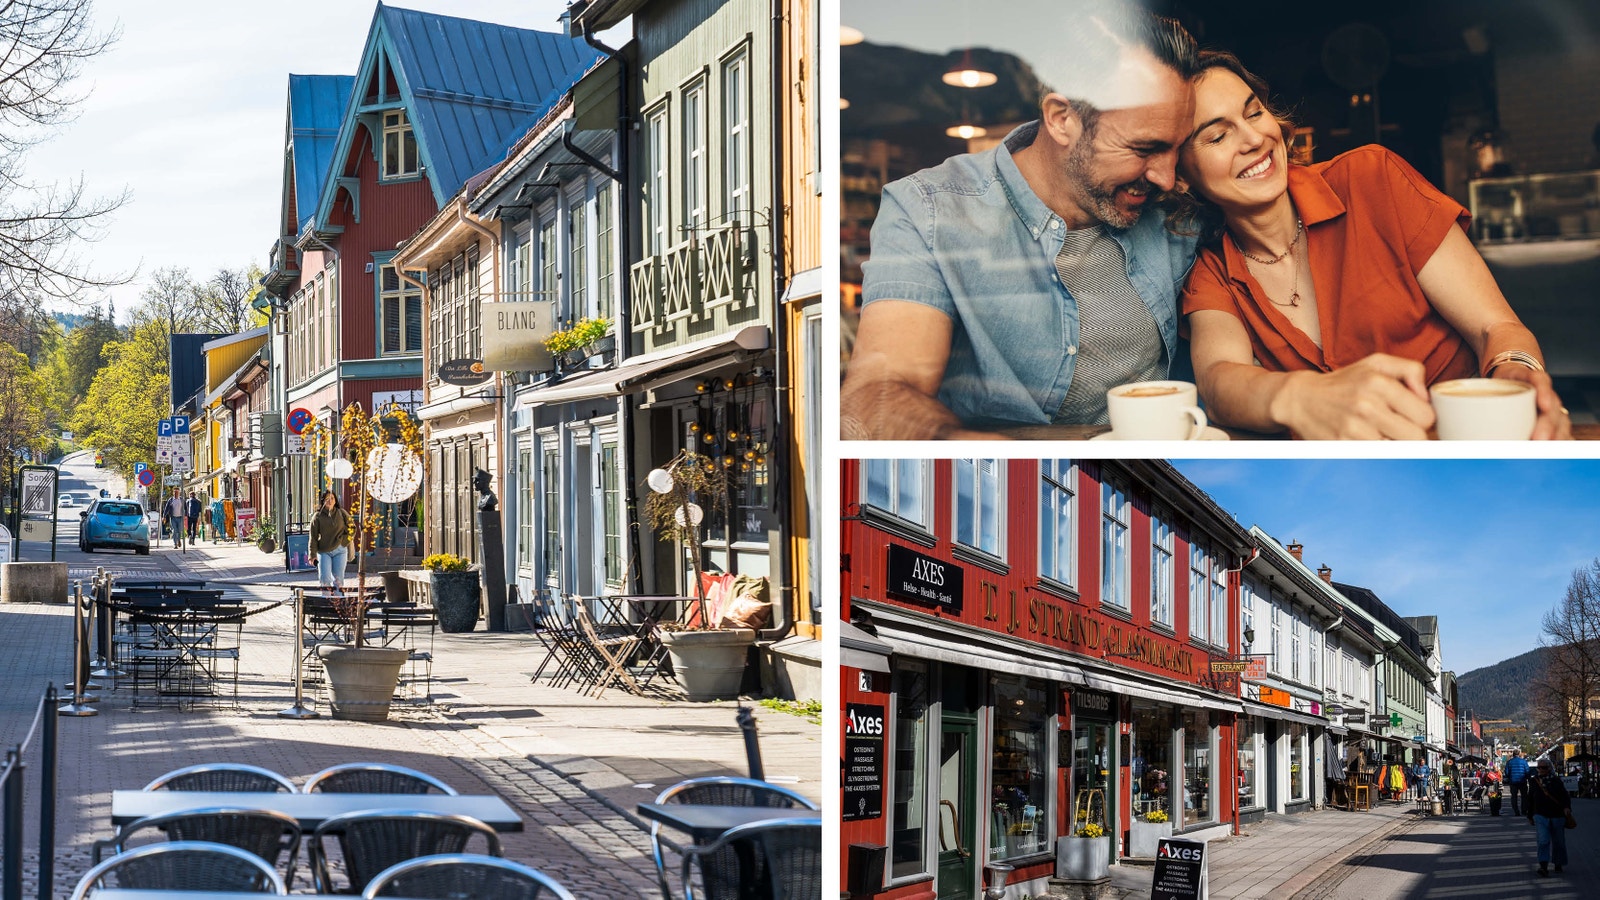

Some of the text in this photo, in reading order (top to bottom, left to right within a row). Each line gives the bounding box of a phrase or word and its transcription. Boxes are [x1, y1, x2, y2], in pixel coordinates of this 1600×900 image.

[498, 310, 536, 330] BLANC
[162, 422, 171, 435] P
[175, 418, 185, 433] P
[137, 464, 145, 473] P
[912, 557, 944, 586] AXES
[903, 581, 917, 593] Helse
[920, 586, 937, 599] Health
[980, 580, 1193, 676] T. J. STRAND GLASSMAGASIN
[846, 709, 883, 734] Axes
[1159, 842, 1201, 861] Axes
